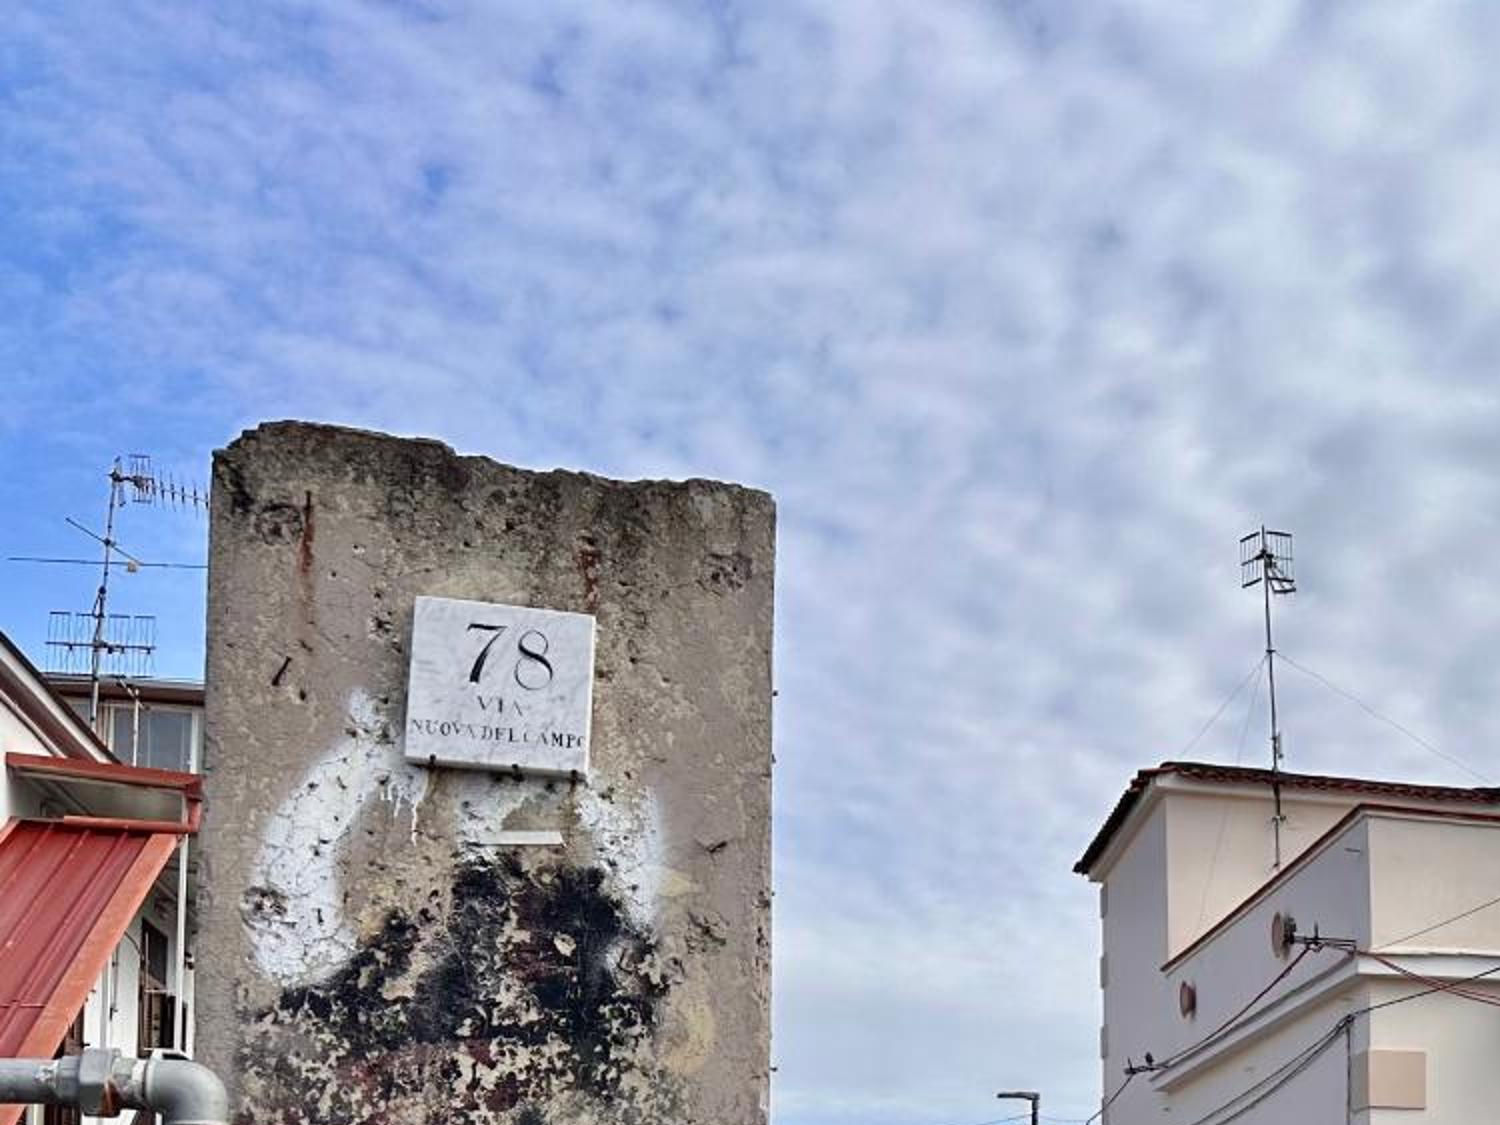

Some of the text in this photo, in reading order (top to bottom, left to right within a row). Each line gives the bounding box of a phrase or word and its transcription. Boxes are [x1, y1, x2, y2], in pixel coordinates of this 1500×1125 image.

[466, 623, 554, 691] 78
[476, 695, 523, 717] VIA
[411, 718, 475, 740] NUOVA
